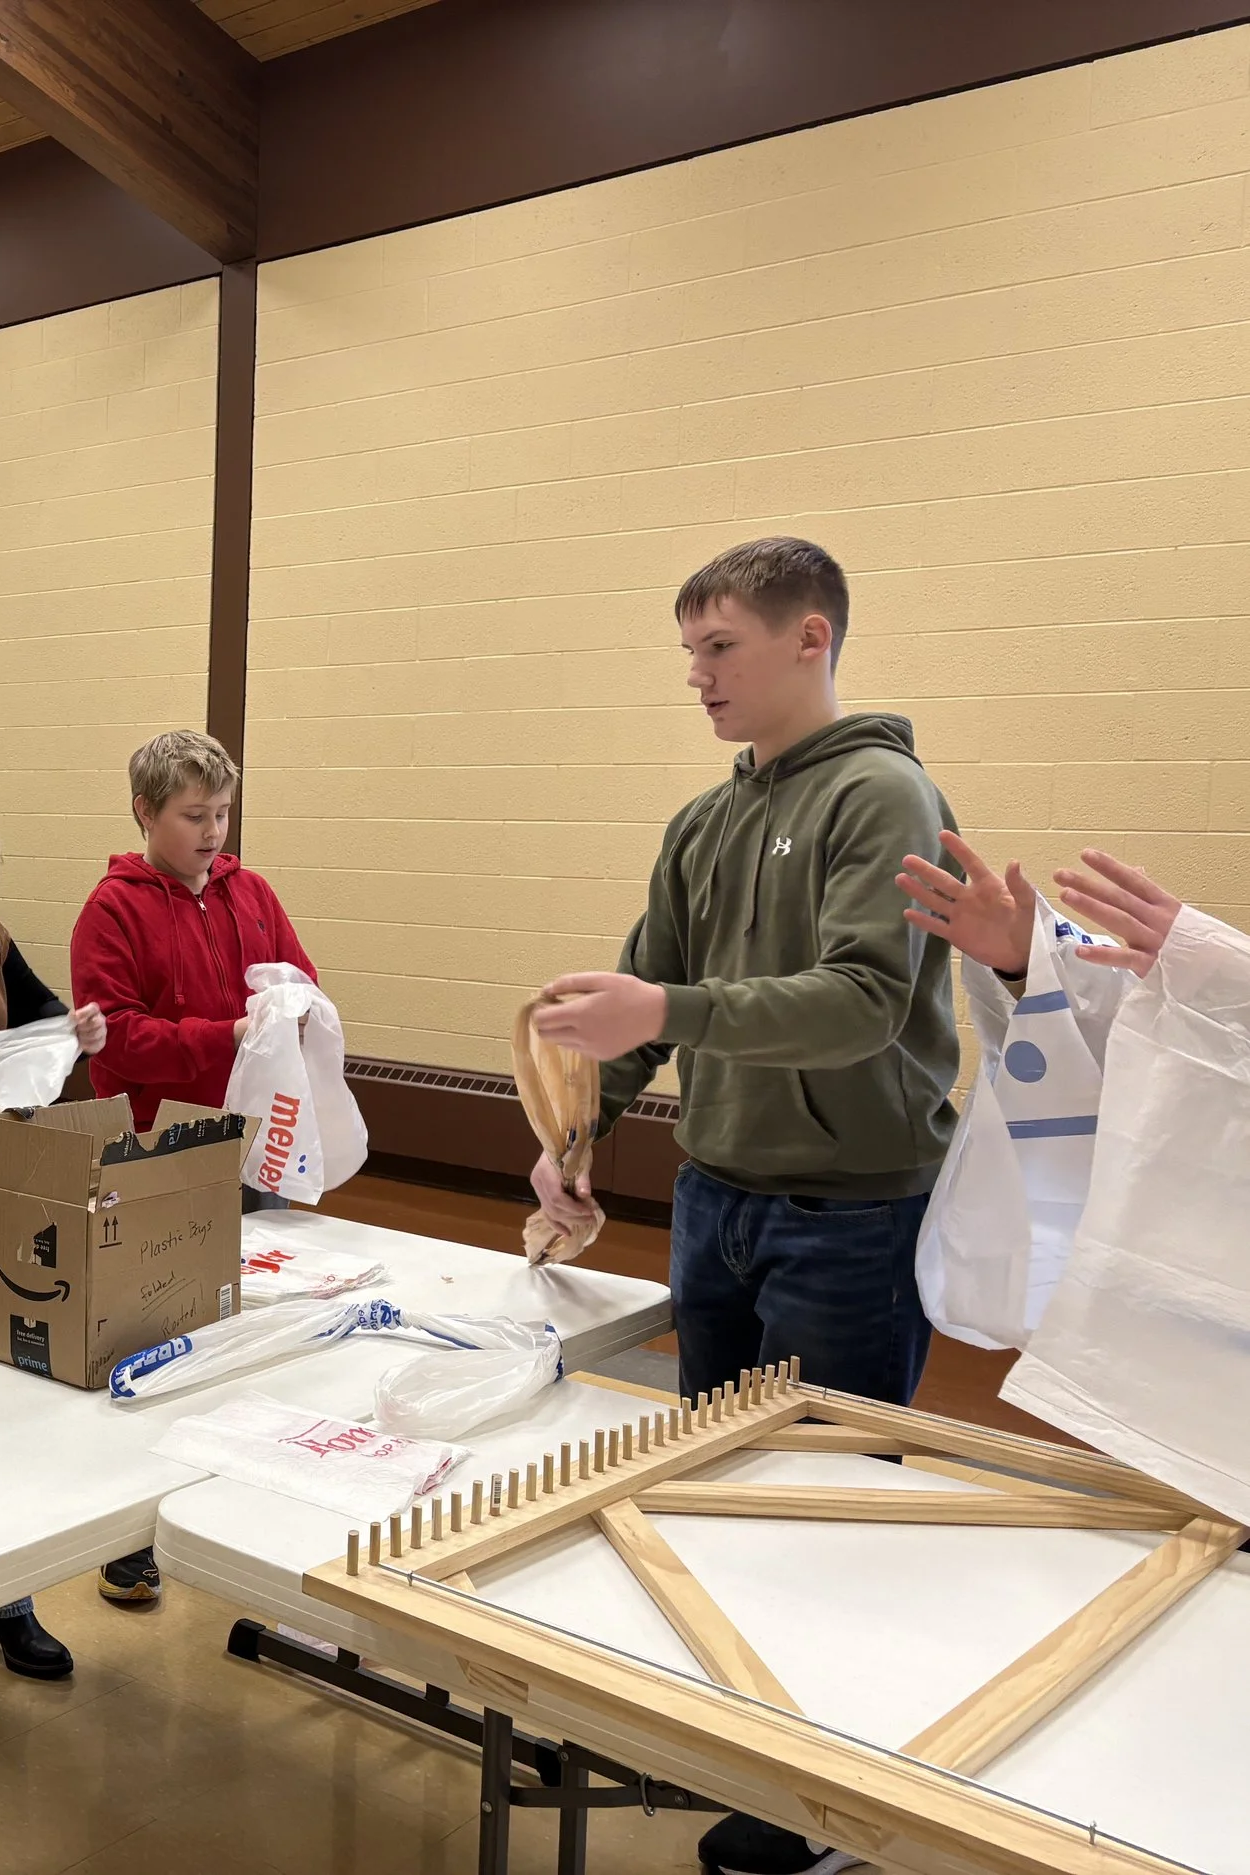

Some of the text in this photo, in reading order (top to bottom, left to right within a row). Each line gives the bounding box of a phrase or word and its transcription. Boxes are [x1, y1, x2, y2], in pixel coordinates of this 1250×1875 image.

[168, 1124, 178, 1146] pri
[140, 1219, 213, 1265] Plastic Bags
[140, 1270, 177, 1302] Folded
[26, 1331, 45, 1343] delivery
[17, 1355, 48, 1372] prime
